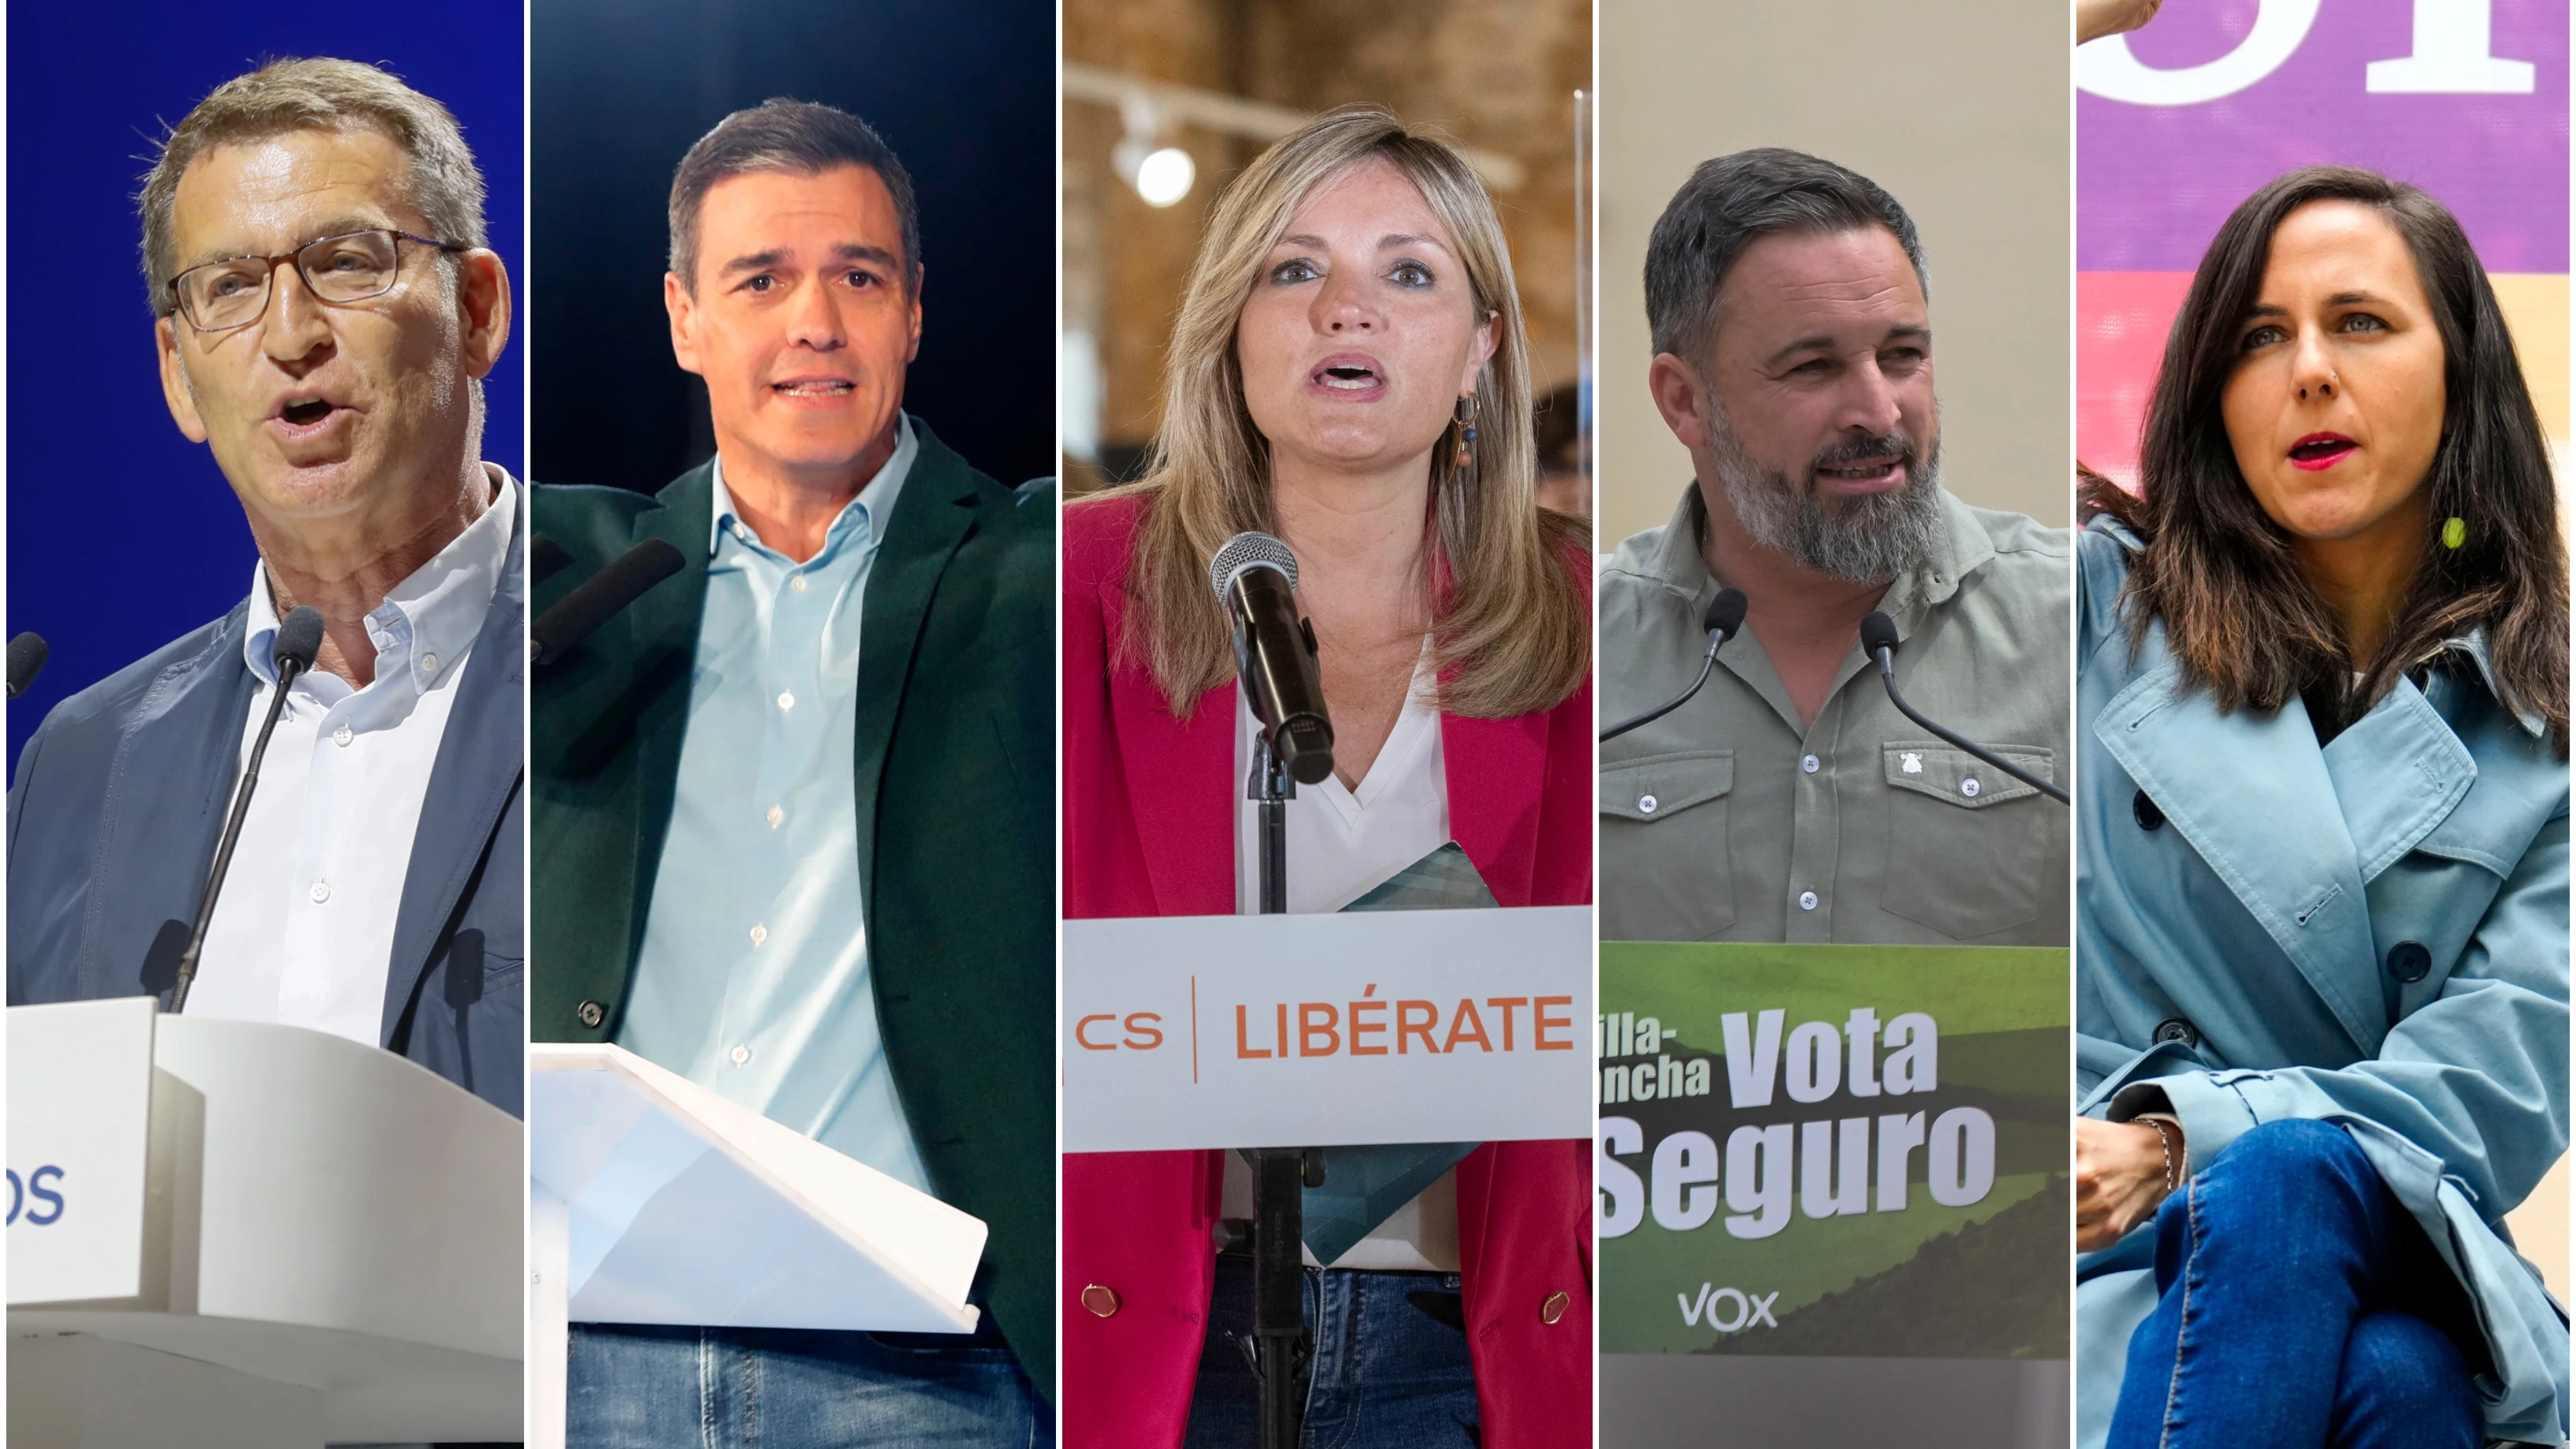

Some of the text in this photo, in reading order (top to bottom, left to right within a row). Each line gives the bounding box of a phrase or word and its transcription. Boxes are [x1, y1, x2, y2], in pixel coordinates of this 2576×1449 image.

[1235, 983, 1574, 1059] LIBÉRATE
[1720, 1007, 1938, 1109] Vota
[1599, 1054, 1711, 1105] ncha
[1599, 1106, 1996, 1240] Seguro
[1677, 1282, 1780, 1332] VOX
